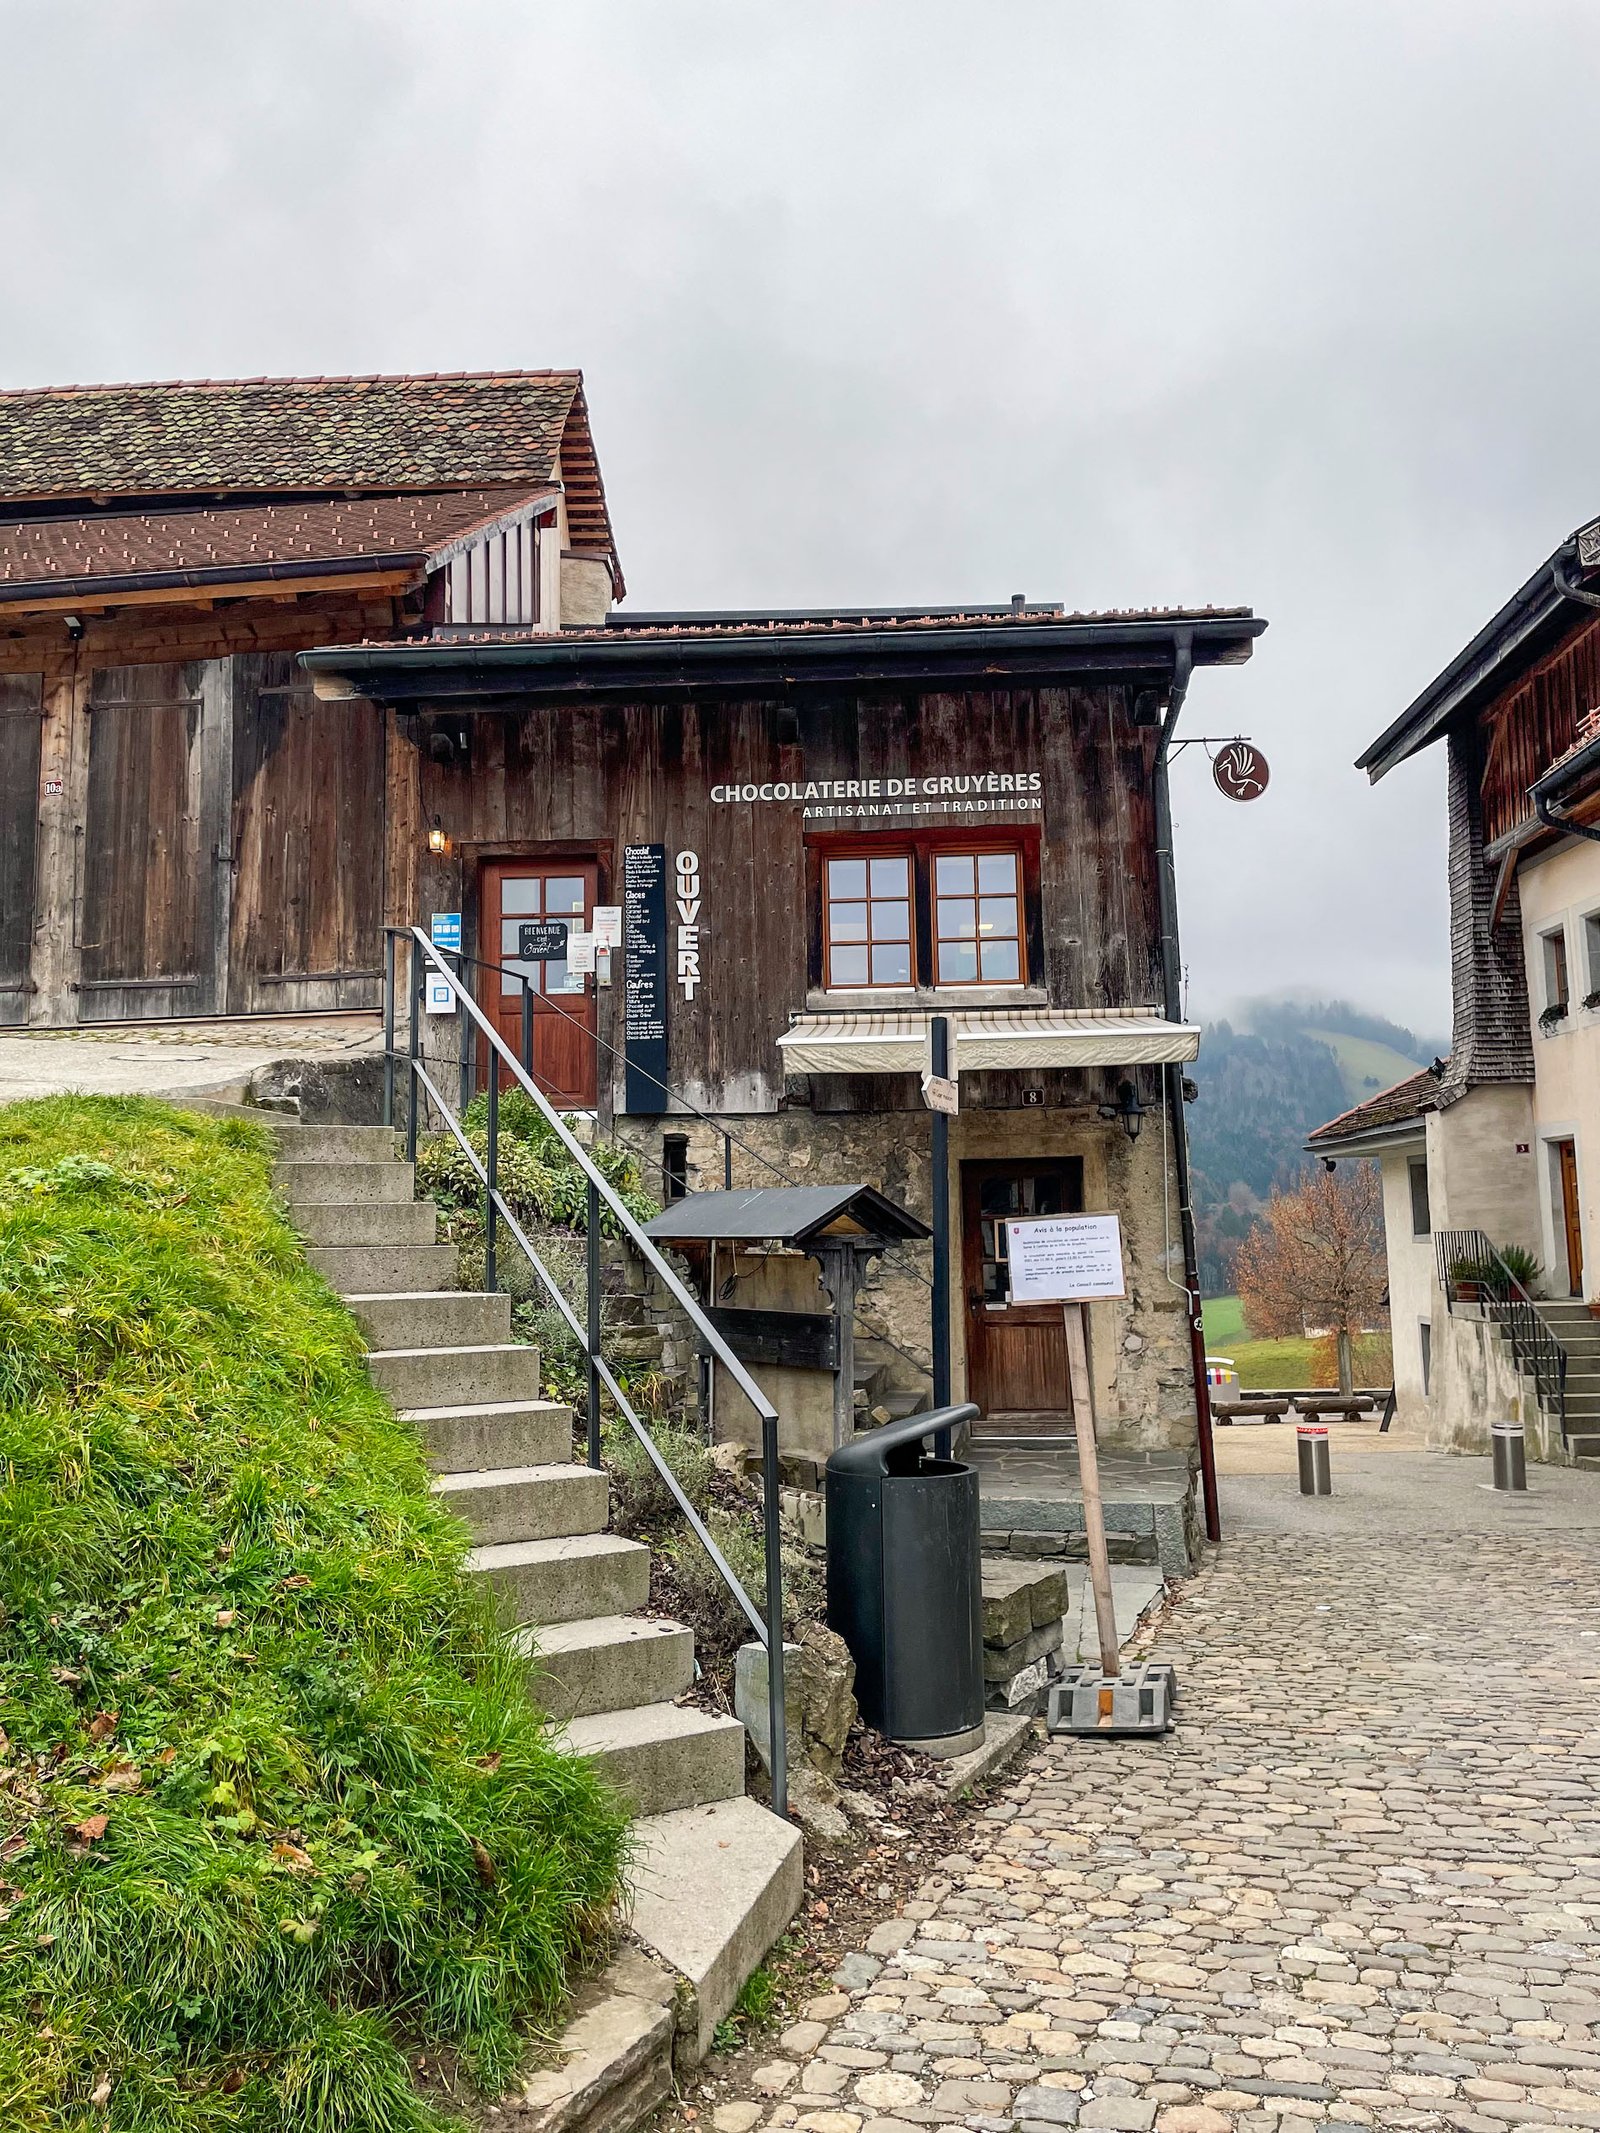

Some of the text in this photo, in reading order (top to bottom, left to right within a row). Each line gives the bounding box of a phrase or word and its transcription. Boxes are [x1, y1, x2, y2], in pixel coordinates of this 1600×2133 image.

[46, 783, 61, 794] 10a
[710, 771, 1042, 803] CHOCOLATERIE DE GRUYÈRES
[802, 798, 1042, 818] ARTISANAT ET TRADITION
[625, 846, 649, 855] Chocolat
[626, 890, 646, 899] Glaces
[675, 850, 701, 1001] OUVERT
[626, 980, 654, 989] Gaufres
[1030, 1092, 1036, 1103] 8
[1065, 1224, 1096, 1232] population
